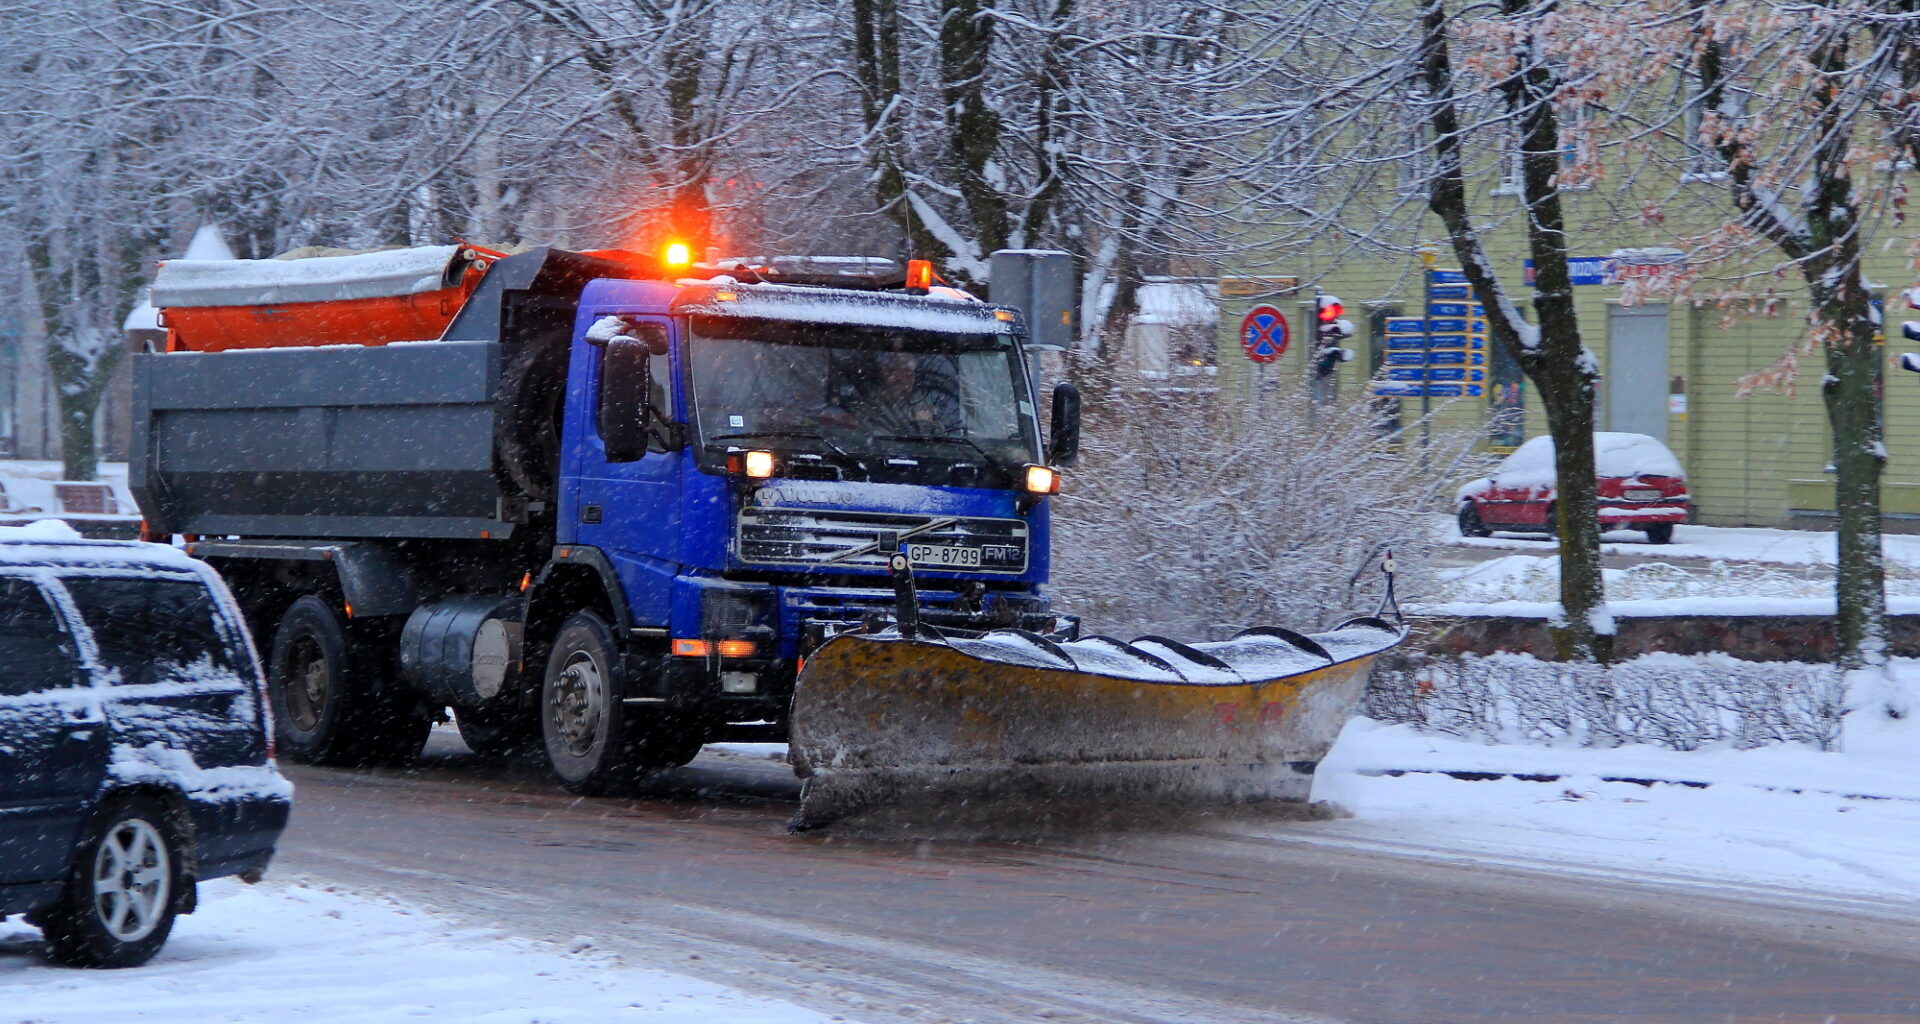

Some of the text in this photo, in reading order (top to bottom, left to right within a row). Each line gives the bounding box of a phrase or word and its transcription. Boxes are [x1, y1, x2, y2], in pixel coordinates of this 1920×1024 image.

[762, 491, 774, 500] LV
[911, 546, 979, 565] GP-8799
[985, 547, 1020, 560] FM12
